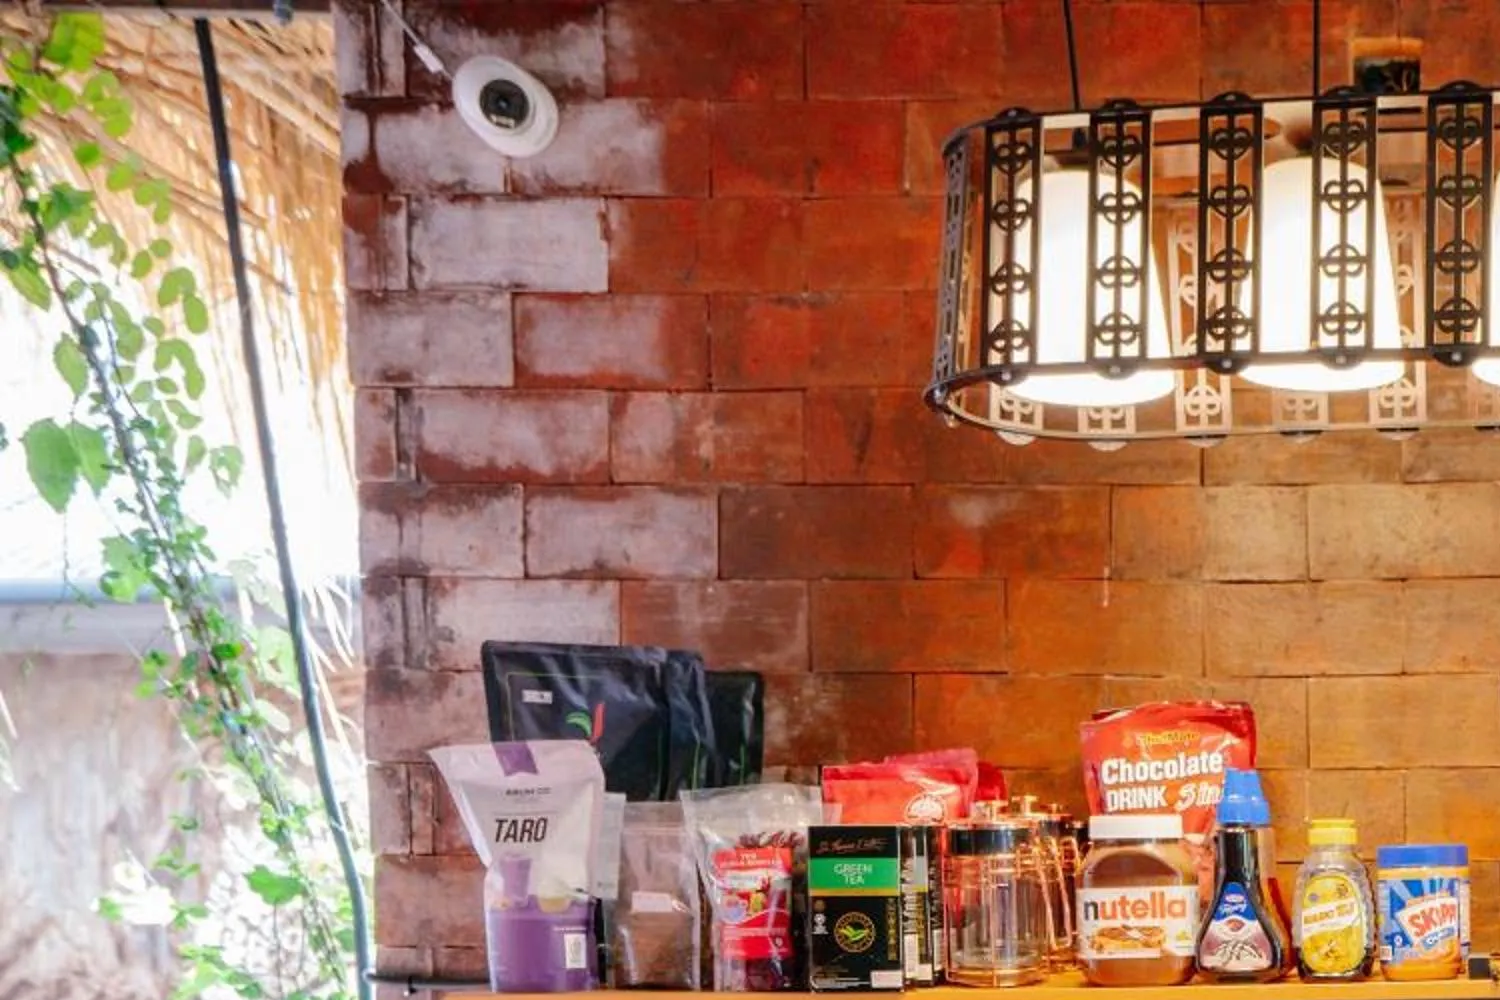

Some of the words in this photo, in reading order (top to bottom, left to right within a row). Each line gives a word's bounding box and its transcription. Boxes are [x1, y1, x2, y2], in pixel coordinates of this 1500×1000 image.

[1102, 751, 1224, 785] Chocolate
[1106, 785, 1168, 811] DRINK
[495, 817, 548, 842] TARO
[833, 863, 872, 875] GREEN
[844, 875, 865, 885] TEA
[1084, 891, 1187, 920] nutella
